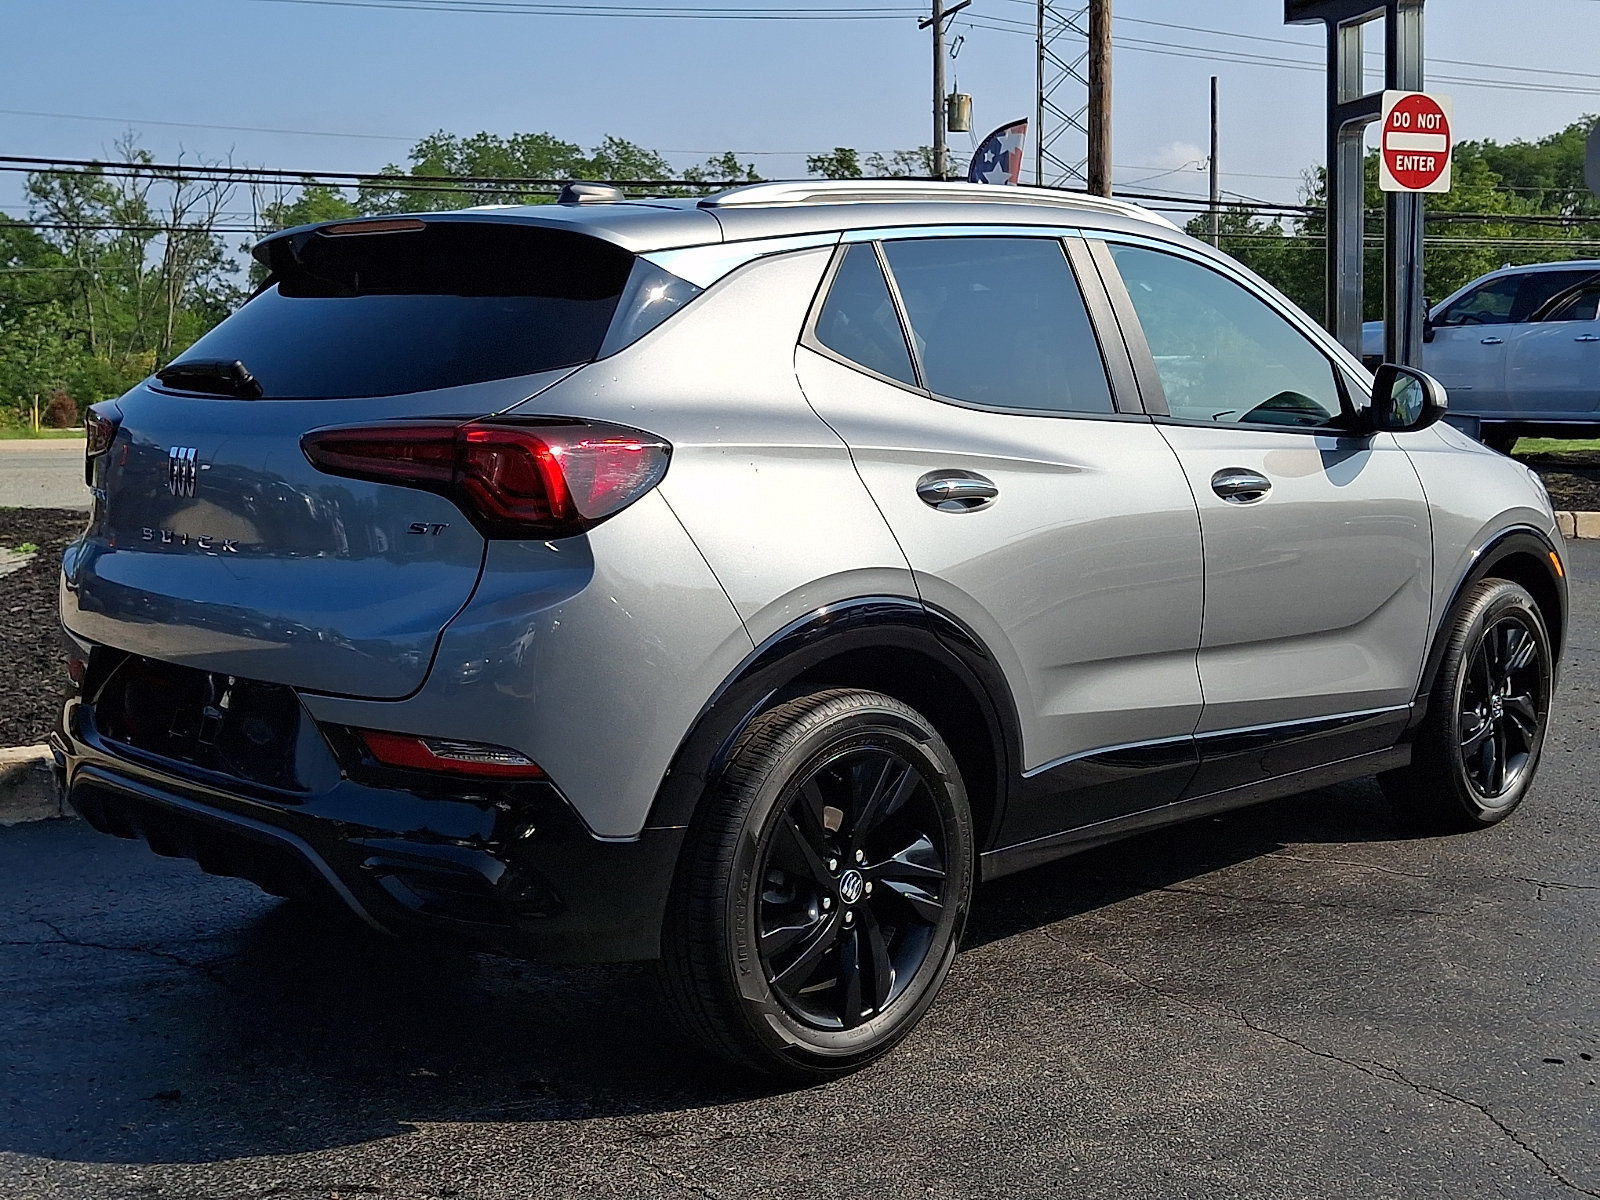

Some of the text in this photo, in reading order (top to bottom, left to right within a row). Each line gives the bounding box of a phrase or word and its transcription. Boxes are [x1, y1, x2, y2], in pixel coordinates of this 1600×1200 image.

[1393, 111, 1443, 130] DO NOT
[1395, 155, 1436, 172] ENTER
[406, 521, 450, 536] ST
[141, 526, 239, 553] BUICK
